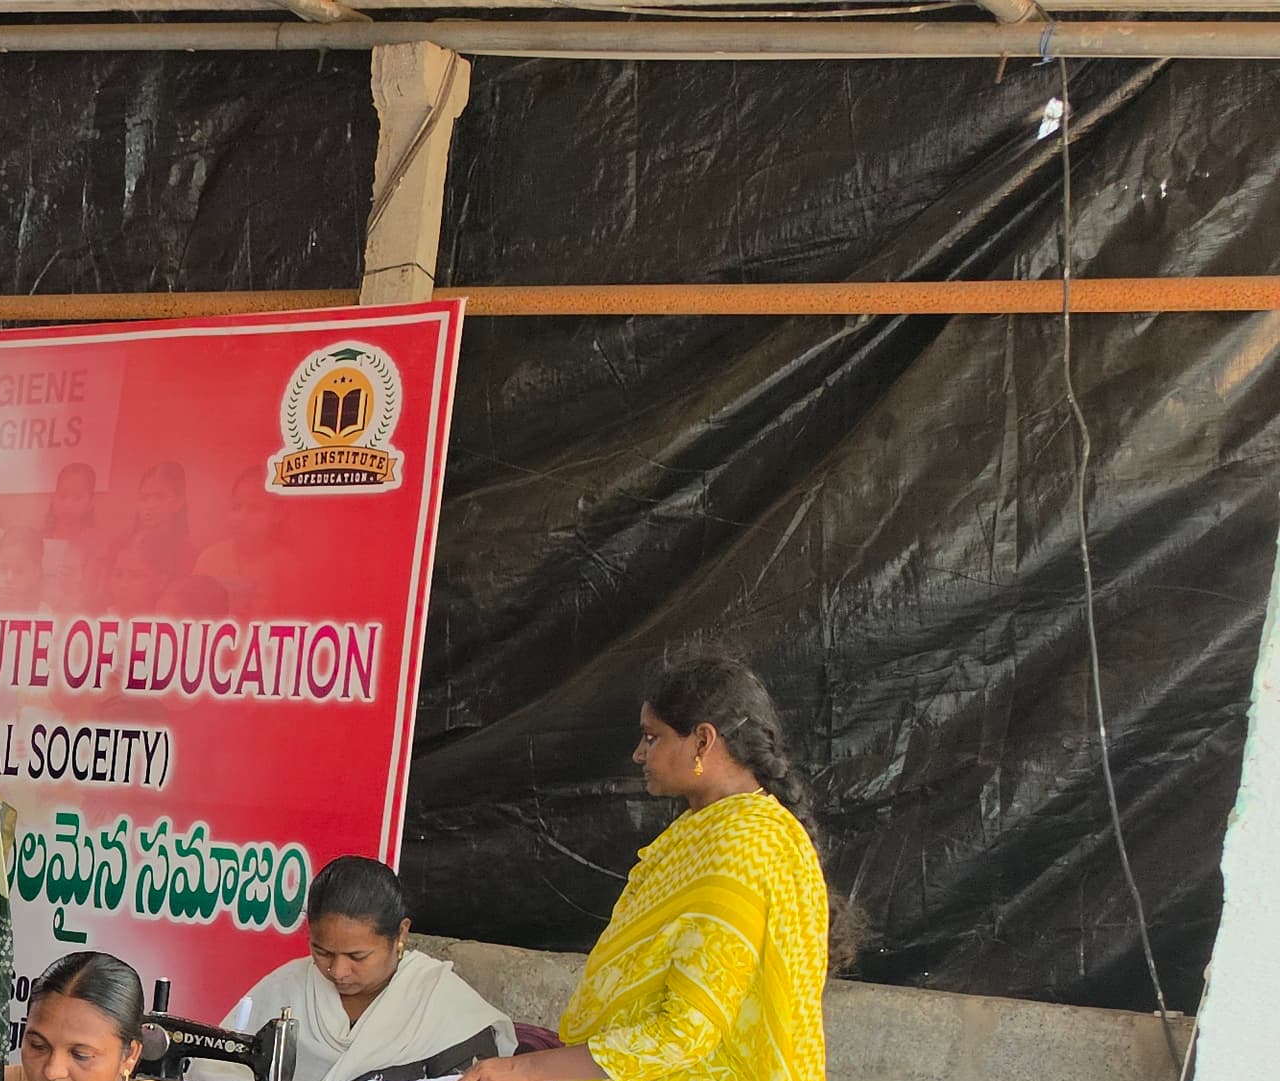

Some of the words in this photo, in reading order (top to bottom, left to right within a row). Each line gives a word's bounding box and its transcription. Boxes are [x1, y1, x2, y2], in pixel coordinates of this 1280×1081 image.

[286, 456, 309, 472] AGF
[314, 451, 386, 470] INSTITUTE
[63, 619, 120, 689] OF
[125, 621, 378, 699] EDUCATION
[27, 725, 169, 788] SOCEITY)
[136, 821, 307, 928] సమాజం
